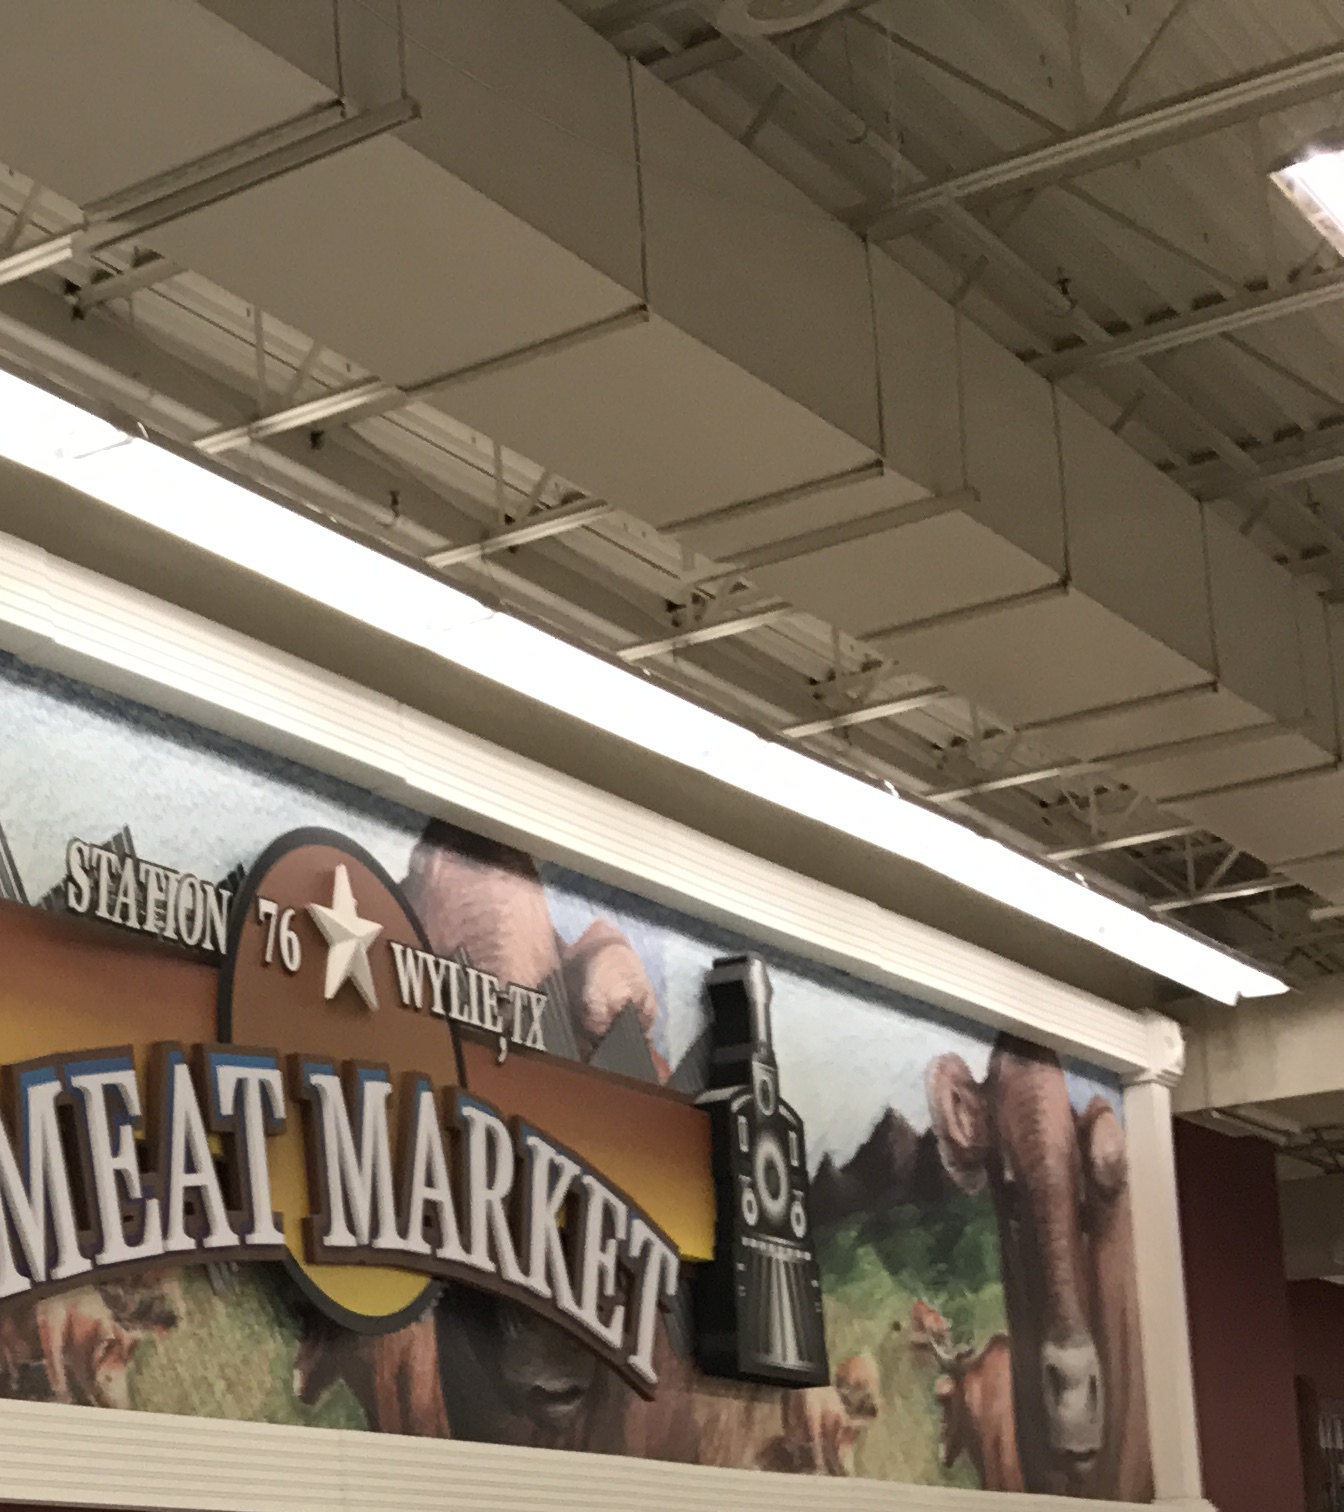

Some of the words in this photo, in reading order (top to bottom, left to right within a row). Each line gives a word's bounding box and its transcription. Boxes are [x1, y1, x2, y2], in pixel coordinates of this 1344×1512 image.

[67, 838, 234, 954] STATION
[258, 897, 302, 973] 76
[308, 1068, 681, 1386] MARKET
